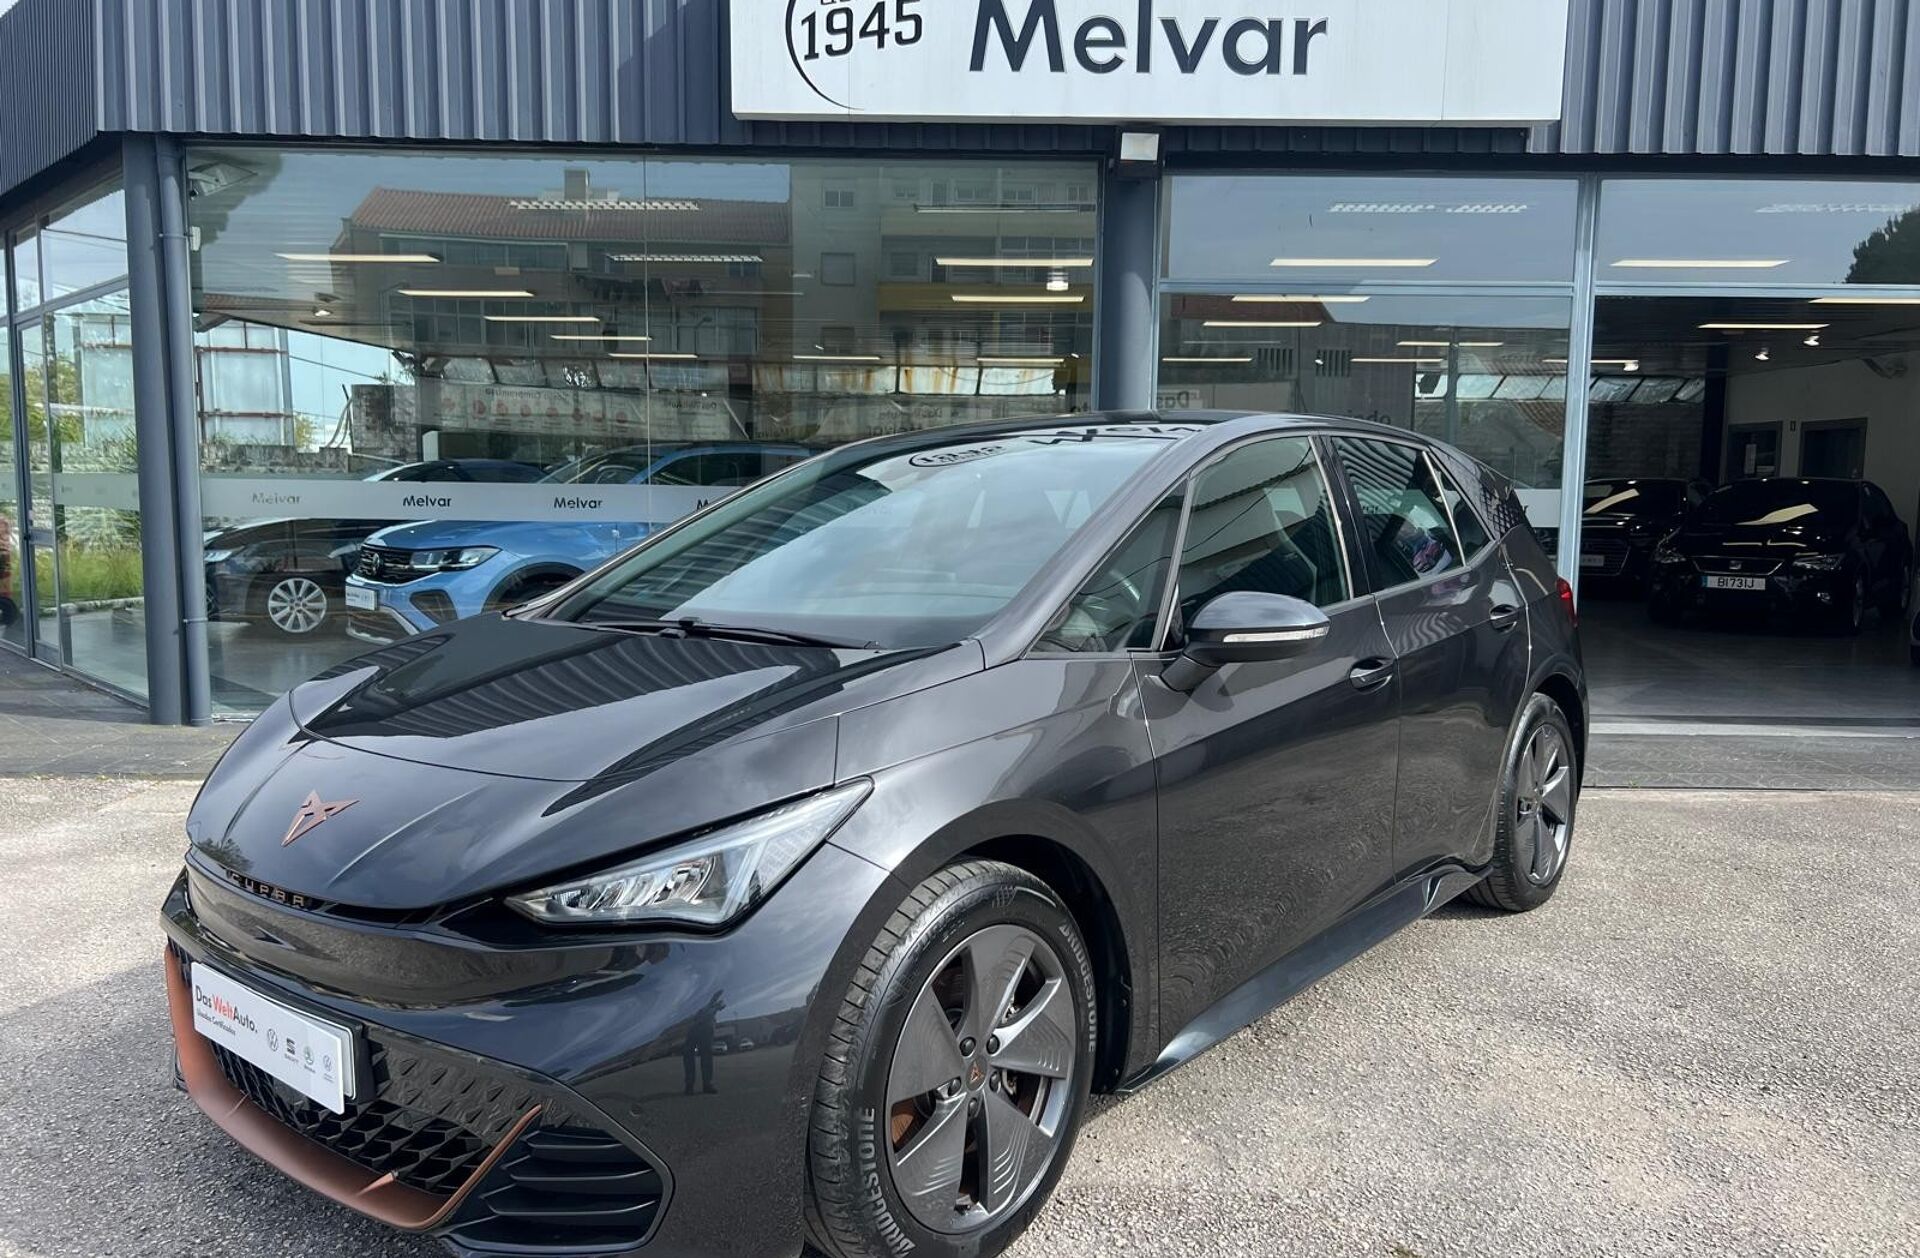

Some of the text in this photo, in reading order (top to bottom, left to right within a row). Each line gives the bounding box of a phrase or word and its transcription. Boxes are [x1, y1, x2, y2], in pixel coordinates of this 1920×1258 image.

[801, 0, 923, 60] 1945
[969, 0, 1328, 76] Melvar
[402, 494, 452, 507] Melvar
[553, 497, 603, 509] Melvar
[856, 1107, 916, 1258] BRIDGESTONE
